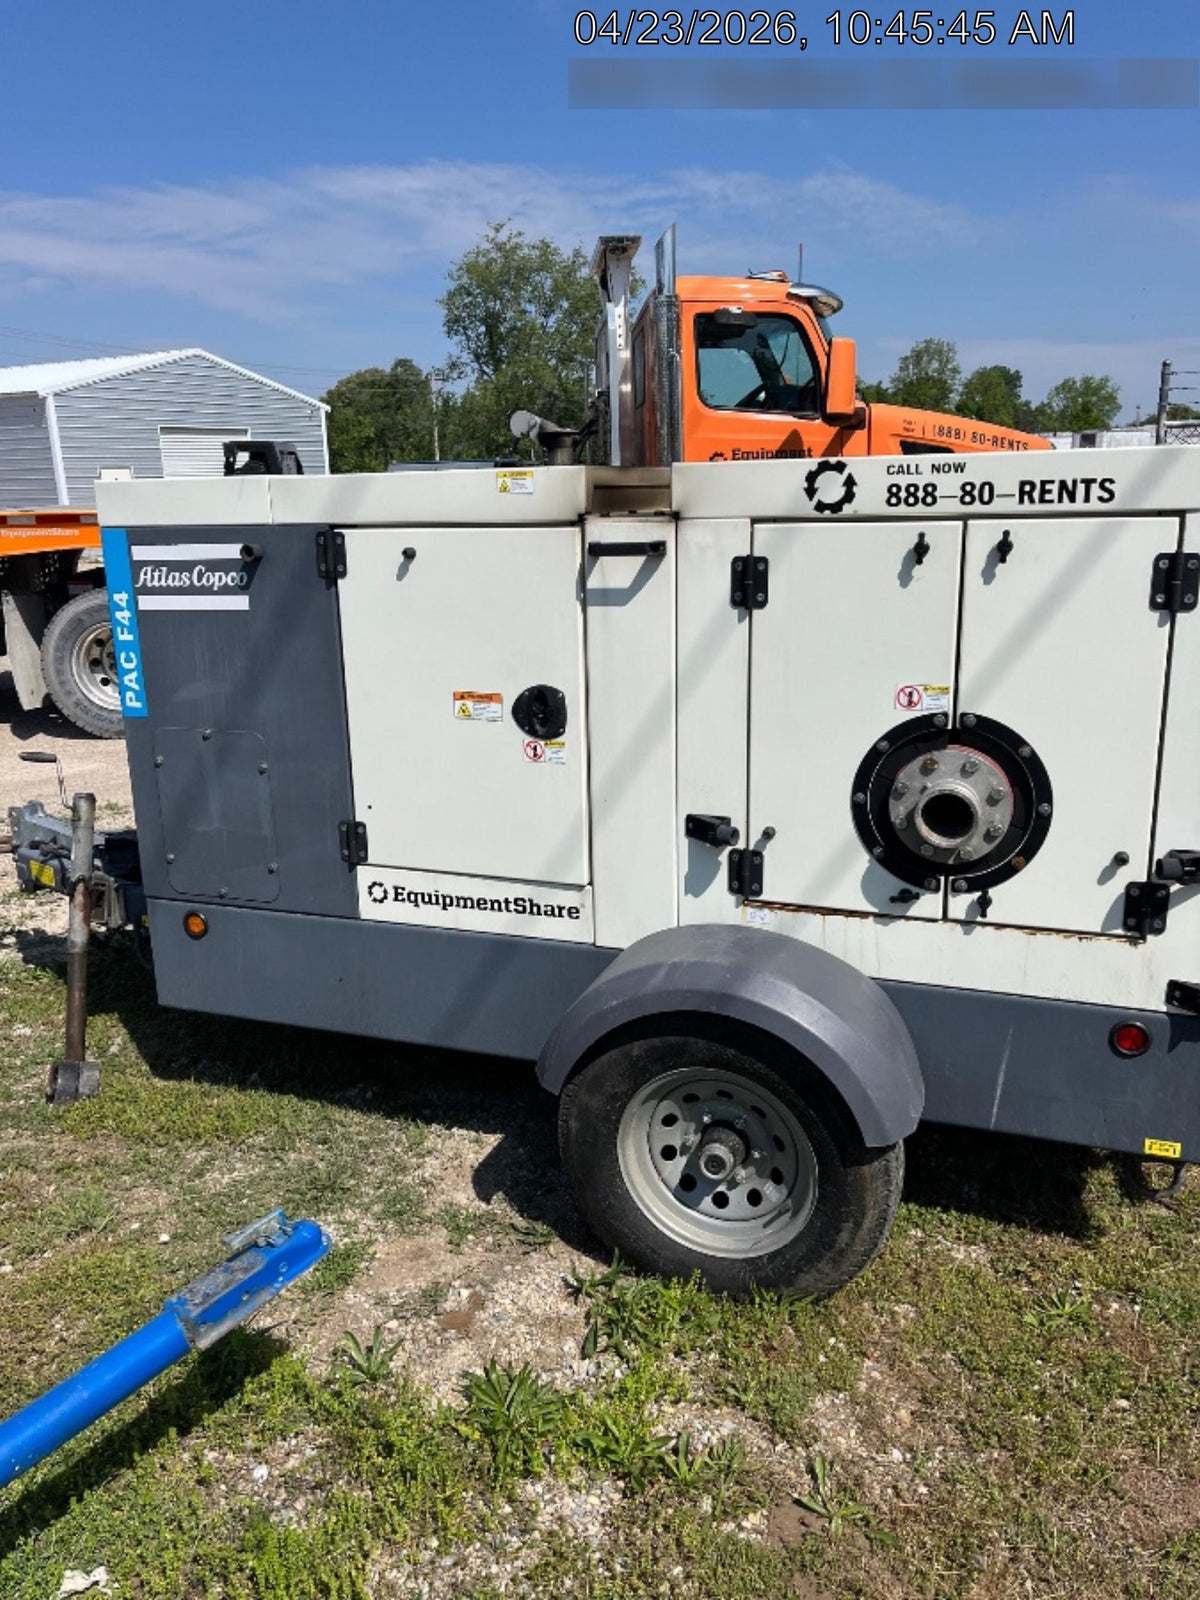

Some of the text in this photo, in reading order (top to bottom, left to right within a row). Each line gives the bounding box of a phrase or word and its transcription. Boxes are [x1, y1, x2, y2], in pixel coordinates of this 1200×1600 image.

[970, 432, 1029, 451] 80-RENTS
[886, 462, 967, 475] CALL NOW
[135, 564, 247, 591] Atlas Copco
[113, 591, 143, 708] PAC F44
[392, 885, 581, 920] EquipmentShare
